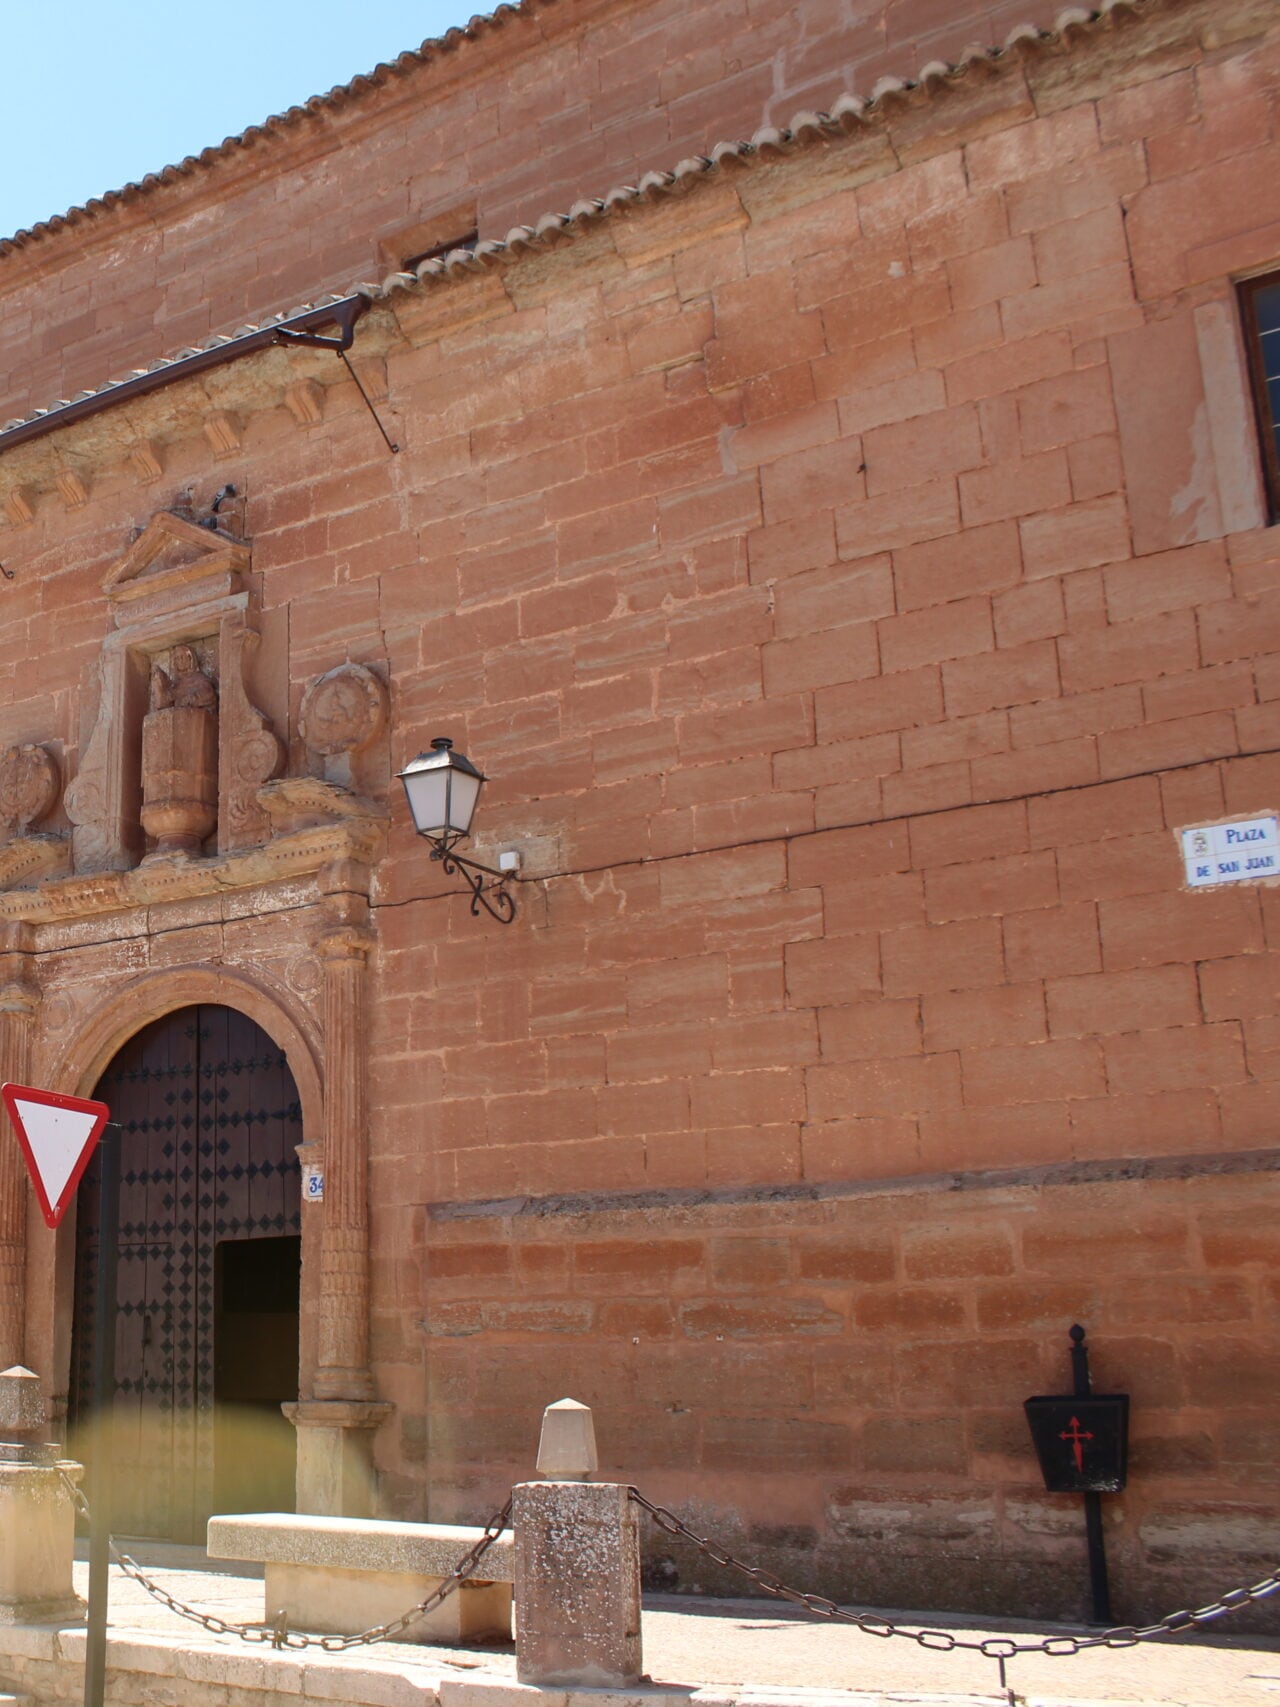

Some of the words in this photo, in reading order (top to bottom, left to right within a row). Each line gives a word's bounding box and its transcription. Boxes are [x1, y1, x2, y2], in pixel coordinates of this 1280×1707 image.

[1226, 829, 1266, 844] PLAZA
[1196, 865, 1211, 877] DE
[1218, 861, 1240, 874] SAN
[1245, 856, 1274, 870] JUAN
